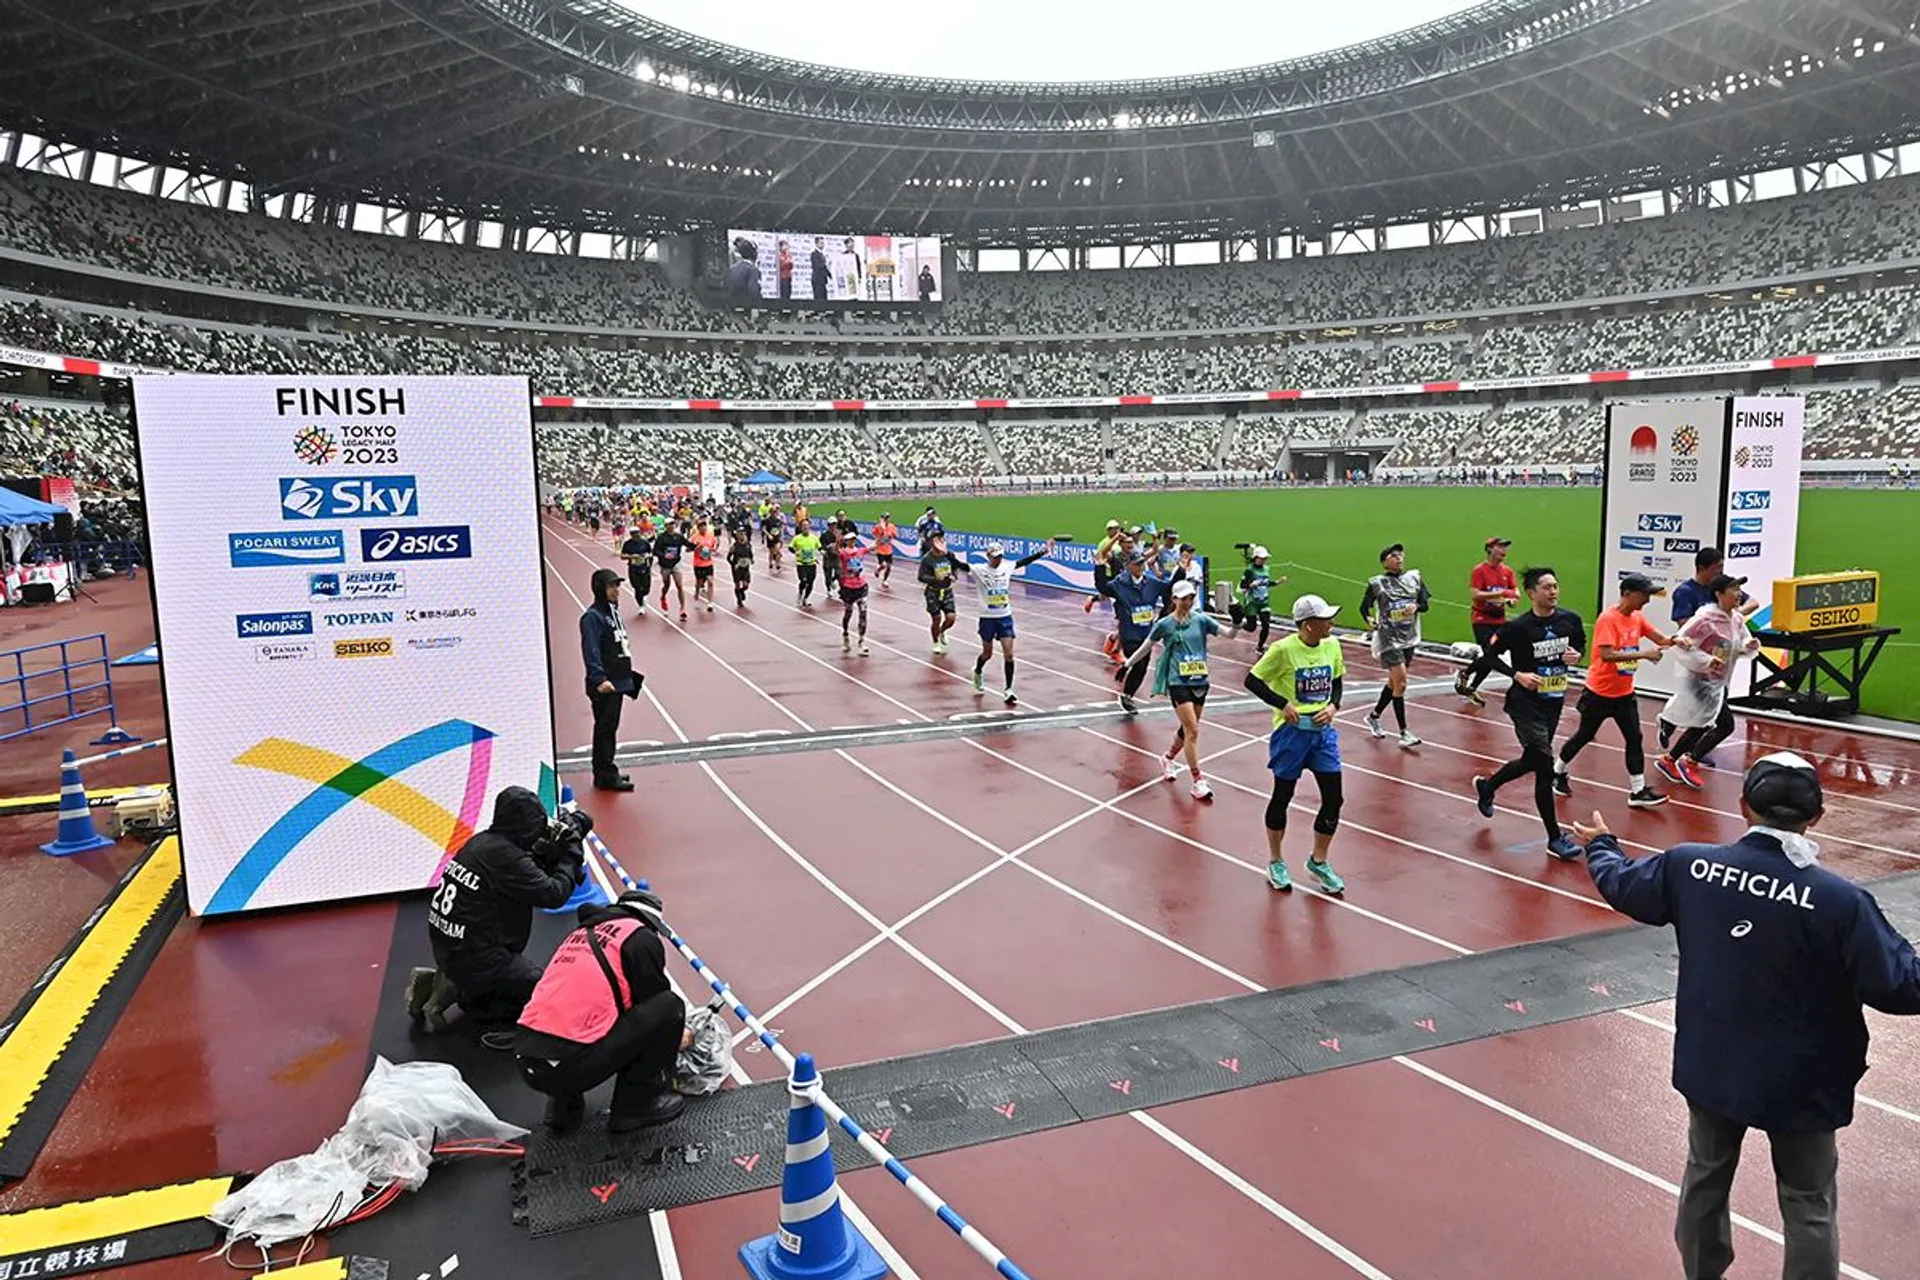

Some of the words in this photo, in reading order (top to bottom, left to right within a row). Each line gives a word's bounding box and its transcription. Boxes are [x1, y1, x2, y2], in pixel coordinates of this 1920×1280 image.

[276, 388, 405, 415] FINISH
[1736, 411, 1784, 428] FINISH
[341, 425, 396, 437] TOKYO
[343, 448, 398, 464] 2023
[1671, 458, 1698, 466] TOKYO
[1751, 458, 1773, 468] 2023
[1670, 472, 1698, 482] 2023
[332, 481, 415, 516] Sky
[1745, 492, 1769, 509] Sky
[1653, 516, 1682, 533] Sky
[234, 537, 288, 549] POCARI
[290, 536, 337, 547] SWEAT
[969, 535, 999, 550] POCA
[346, 583, 403, 594] ツーリスト
[324, 611, 393, 626] TOPPAN
[1810, 608, 1860, 628] SEIKO
[242, 619, 305, 634] Salonpas
[336, 641, 390, 656] SEIKO
[1690, 858, 1816, 910] OFFICIAL
[431, 876, 458, 917] 28
